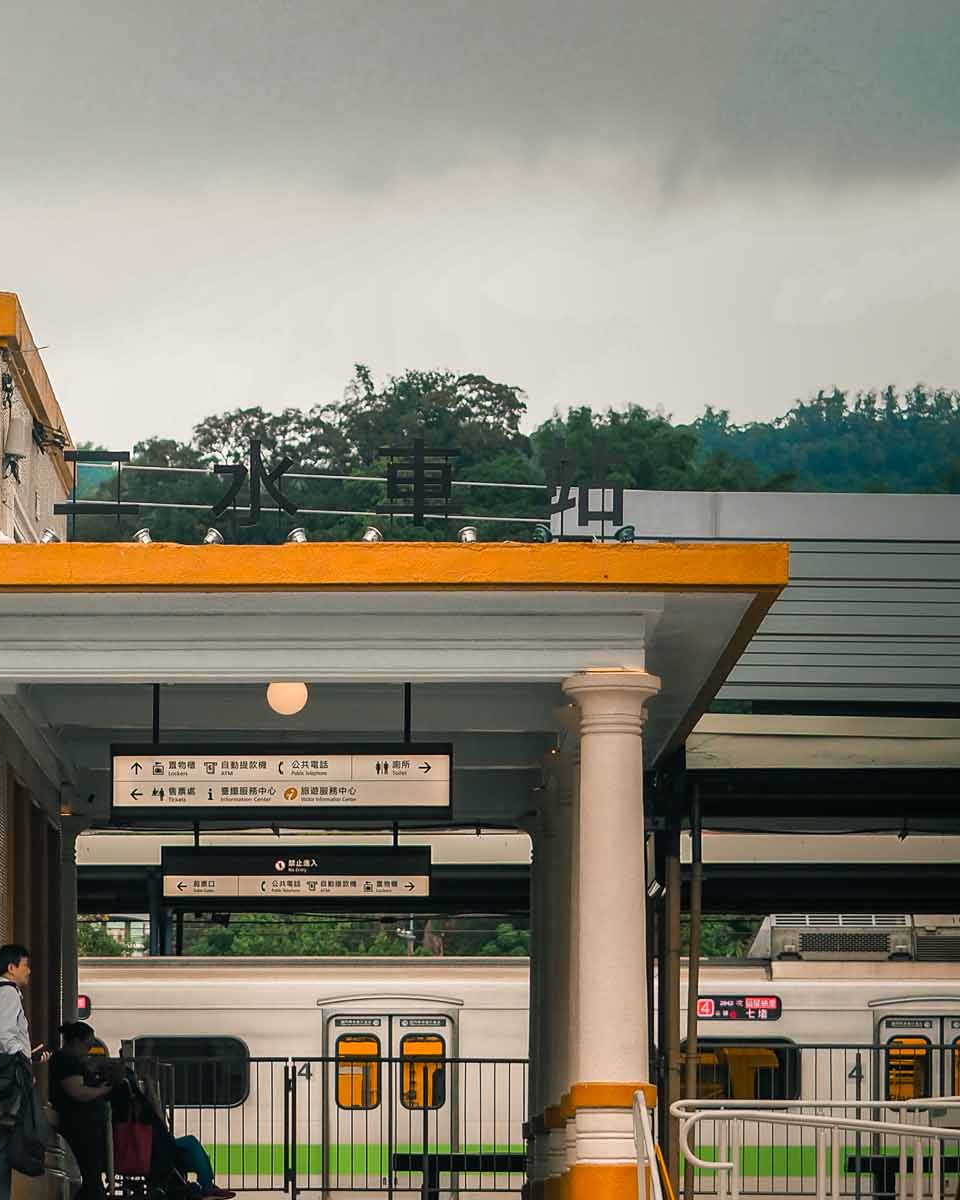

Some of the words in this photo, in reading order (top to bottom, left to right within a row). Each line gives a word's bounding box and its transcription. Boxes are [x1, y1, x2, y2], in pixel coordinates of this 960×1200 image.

[221, 761, 267, 769] 自動提款機
[291, 760, 329, 769] 公共電話
[297, 1061, 313, 1080] 4
